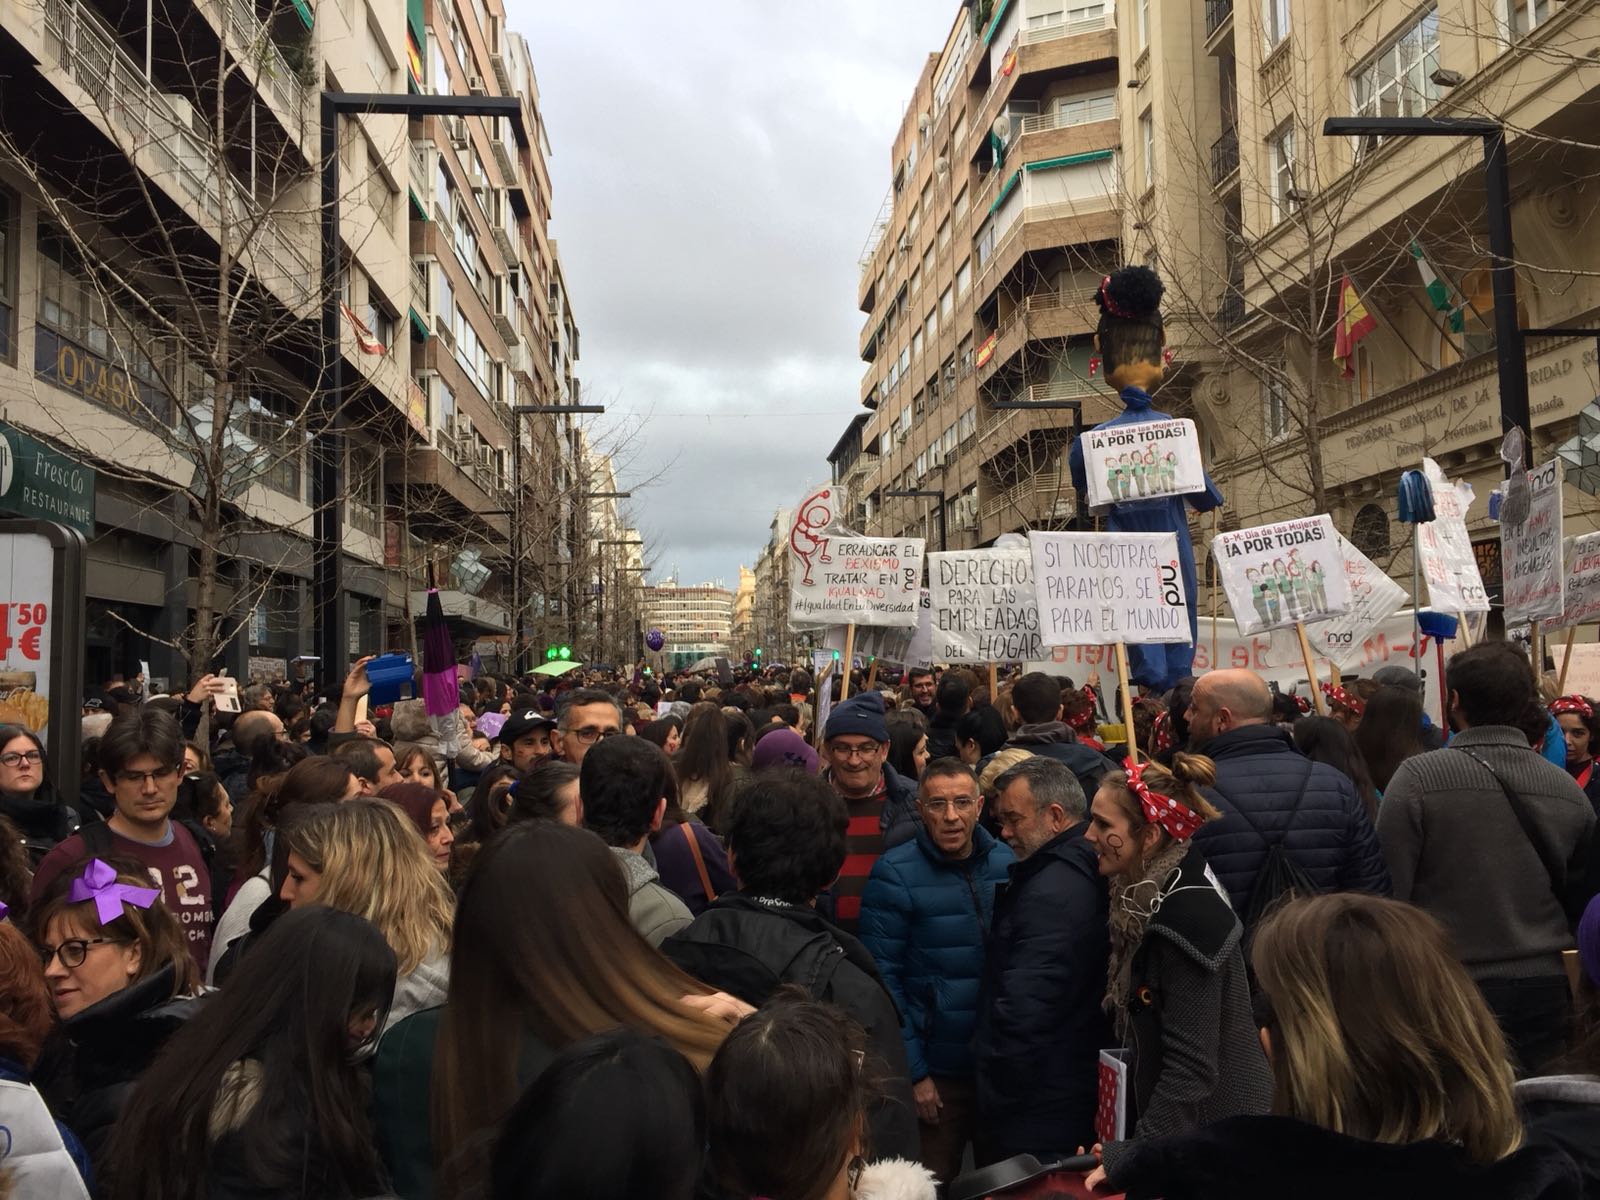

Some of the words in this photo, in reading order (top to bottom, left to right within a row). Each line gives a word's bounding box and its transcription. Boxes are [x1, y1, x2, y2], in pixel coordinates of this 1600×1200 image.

[60, 345, 139, 416] OCASO
[1453, 395, 1468, 413] DE
[1474, 388, 1490, 404] LA
[1152, 420, 1185, 431] Mujeres
[1108, 435, 1135, 447] POR
[23, 486, 91, 526] RESTAURANTE
[1261, 527, 1273, 537] de
[1273, 526, 1288, 534] las
[1288, 518, 1323, 531] Mujeres
[838, 544, 897, 557] ERRADICAR
[904, 545, 919, 558] EL
[1244, 537, 1274, 554] POR
[1275, 526, 1326, 548] TODAS!
[845, 558, 900, 570] SEXISMO
[1045, 542, 1061, 568] SI
[1073, 543, 1158, 569] NOSOTRAS
[825, 573, 868, 585] TRATAR
[879, 573, 898, 585] EN
[940, 560, 1035, 585] DERECHO
[828, 587, 886, 598] IGUALDAD
[948, 589, 980, 605] PARA
[992, 587, 1017, 604] LAS
[1136, 577, 1153, 600] SE
[939, 607, 1039, 632] EMPLEADAS
[1052, 608, 1093, 633] PARA
[1101, 608, 1119, 632] EL
[1127, 607, 1180, 630] MUNDO
[945, 645, 965, 657] DEL
[978, 633, 1041, 660] HOGAR
